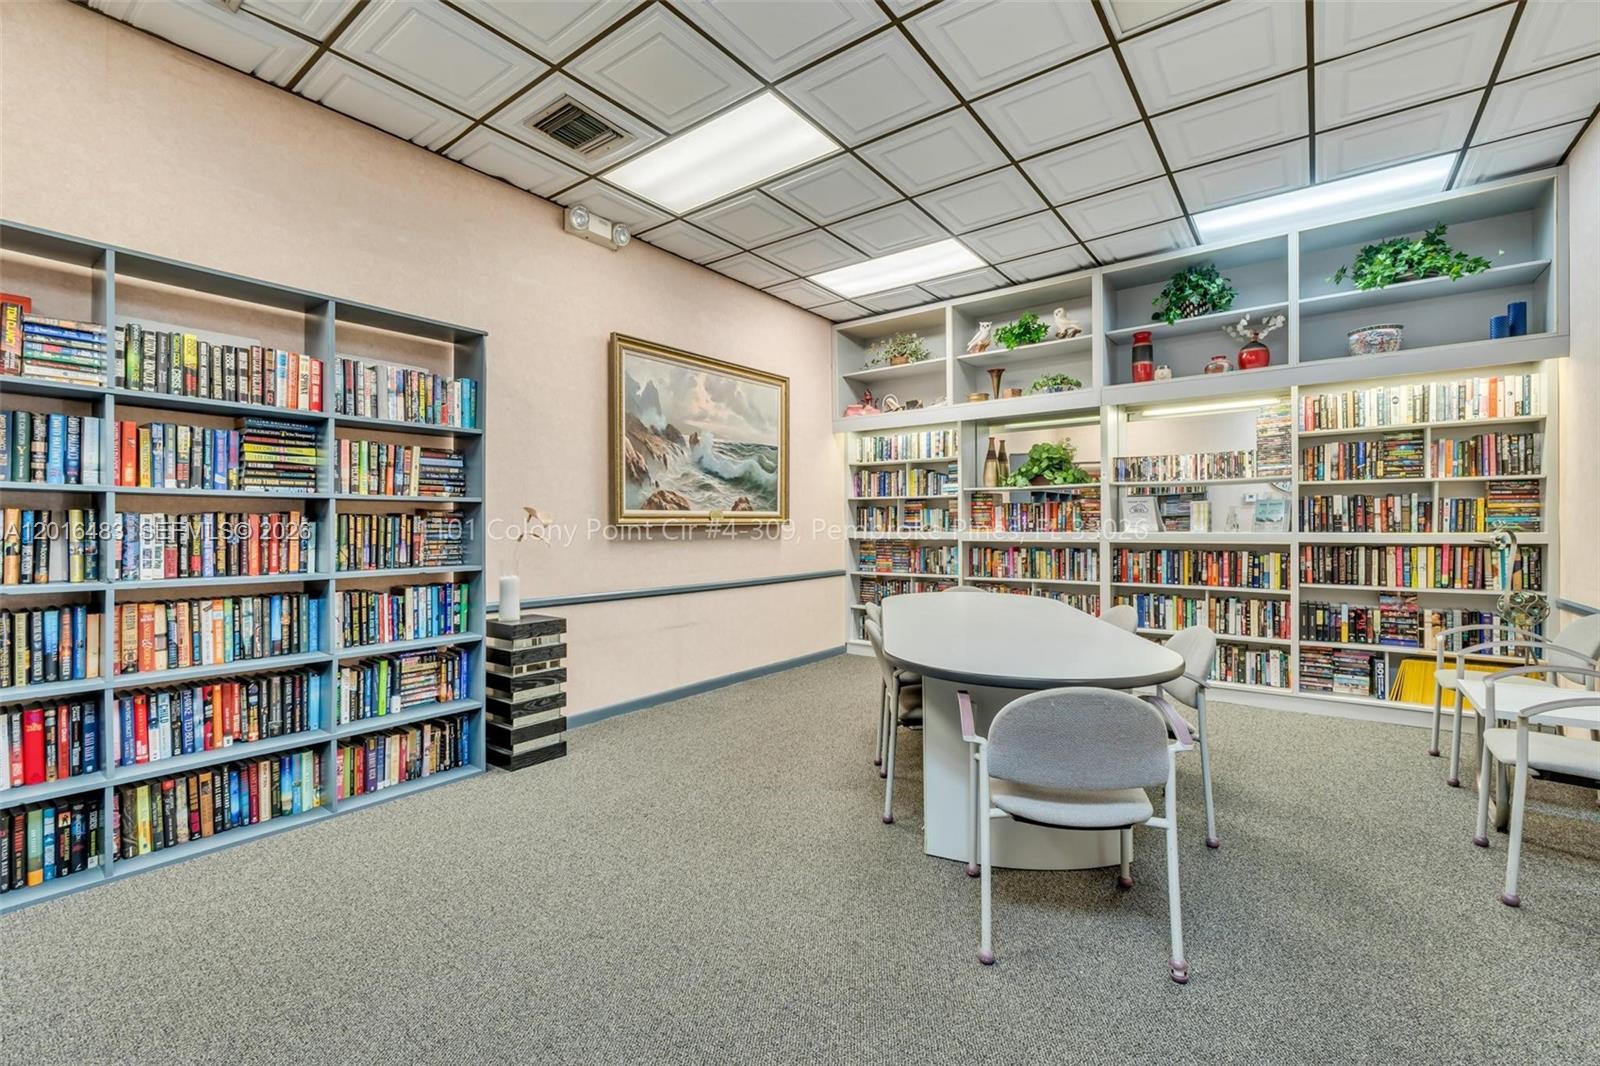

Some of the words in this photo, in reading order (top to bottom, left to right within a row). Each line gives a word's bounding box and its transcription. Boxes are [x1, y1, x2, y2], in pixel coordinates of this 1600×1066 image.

[183, 691, 193, 717] HAWKE
[159, 704, 169, 723] CHILD
[184, 718, 193, 731] TED
[184, 731, 194, 748] BELL
